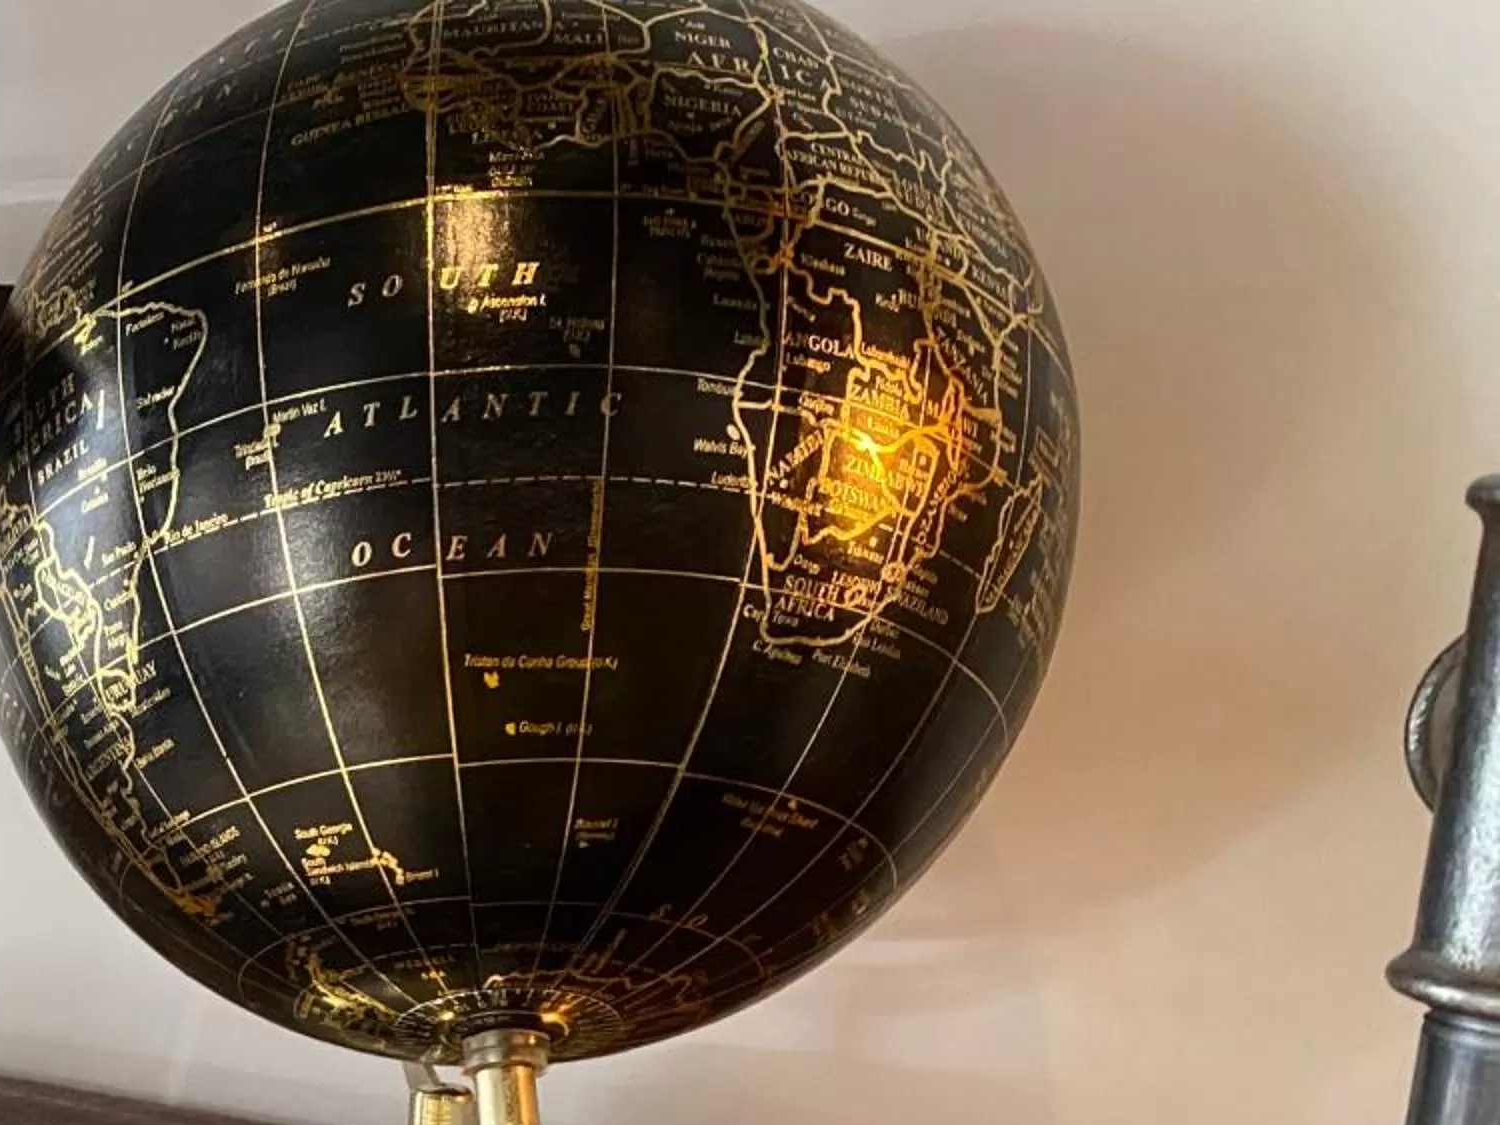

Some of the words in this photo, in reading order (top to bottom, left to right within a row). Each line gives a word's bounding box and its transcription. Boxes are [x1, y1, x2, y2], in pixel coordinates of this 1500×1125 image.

[844, 242, 893, 272] ZAIRE
[347, 262, 540, 308] SOUTH
[783, 331, 856, 361] ANGOLA
[323, 391, 622, 439] ATLANTIC
[36, 438, 91, 487] BRAZIL
[350, 531, 553, 568] OCEAN
[774, 595, 835, 622] AFRICA
